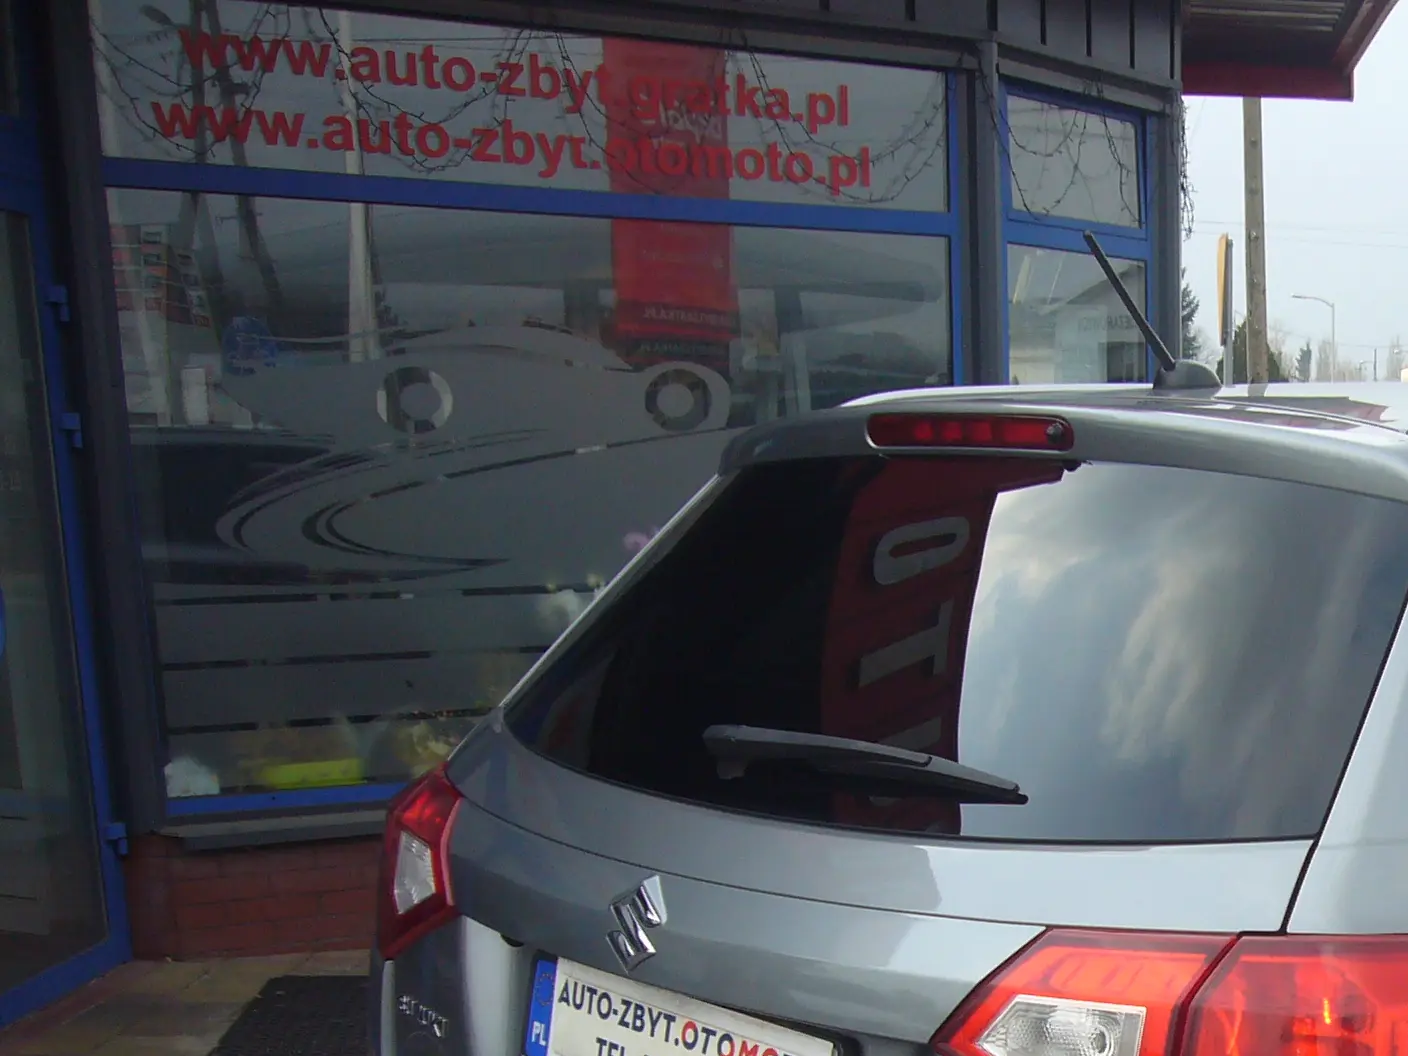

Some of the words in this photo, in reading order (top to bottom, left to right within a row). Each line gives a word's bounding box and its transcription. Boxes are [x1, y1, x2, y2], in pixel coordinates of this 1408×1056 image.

[178, 28, 849, 134] www.auto-zbyt.gratka.pl
[151, 101, 871, 195] www.auto-zbyt.otomoto.pl
[531, 1020, 546, 1046] PL
